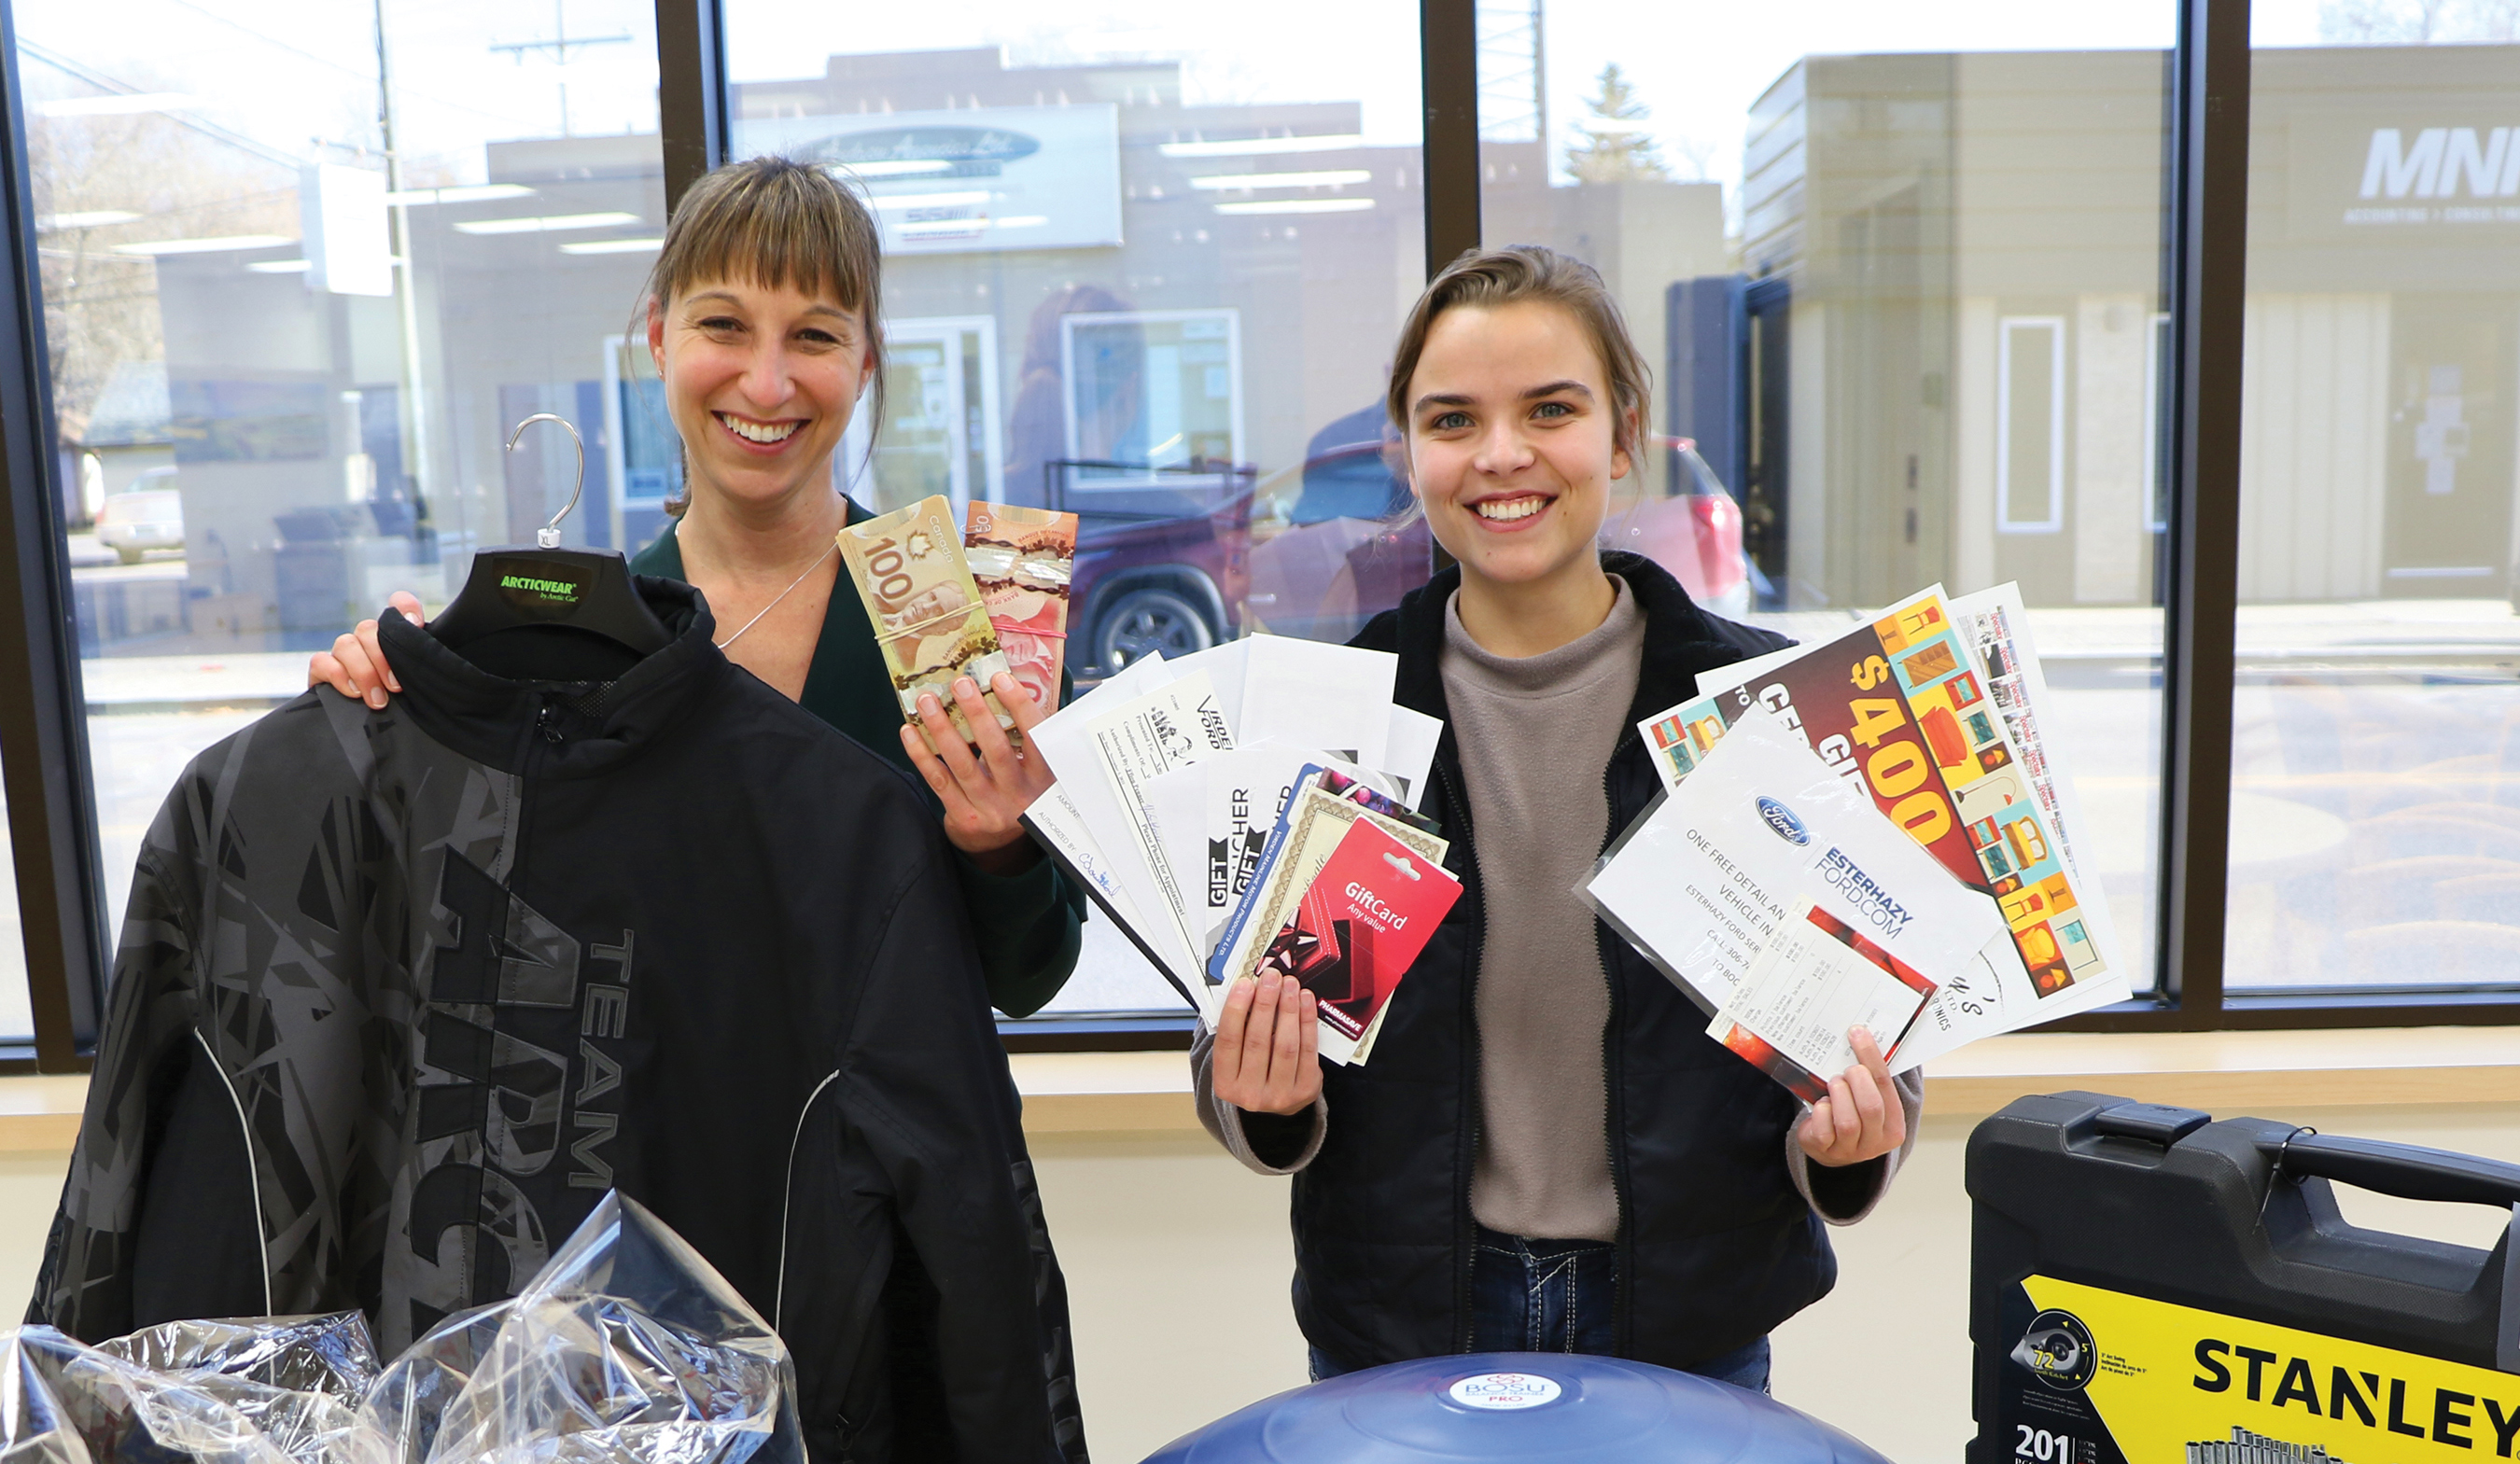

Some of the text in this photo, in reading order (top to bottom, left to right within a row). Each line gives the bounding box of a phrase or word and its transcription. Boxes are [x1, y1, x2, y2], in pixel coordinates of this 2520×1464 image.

[541, 536, 551, 546] XL
[929, 515, 954, 564] Canada
[500, 576, 573, 594] ARCTICWEAR
[863, 537, 914, 600] 100
[1734, 685, 1750, 706] TO
[1110, 728, 1126, 758] Authorized
[1123, 720, 1141, 757] Compliments
[1135, 715, 1150, 742] Presented
[1200, 710, 1221, 750] FORD
[1849, 655, 1952, 845] $400
[1037, 811, 1077, 851] AUTHORIZED BY:
[1762, 803, 1801, 843] Ford
[1141, 823, 1154, 844] Please
[1150, 844, 1162, 864] Phone
[1158, 864, 1167, 874] for
[1163, 875, 1185, 916] Appointment
[1211, 857, 1227, 904] GIFT
[1687, 829, 1711, 853] ONE
[1708, 848, 1736, 875] FREE
[1733, 871, 1769, 907] DETAIL
[1823, 846, 1913, 925] ESTERHAZY
[1345, 882, 1407, 930] GiftCard
[1347, 903, 1386, 933] Any value
[1685, 884, 1727, 922] ESTERHAZY
[1724, 919, 1746, 941] FORD
[1719, 884, 1762, 926] VEHICLE
[1813, 857, 1903, 940] FORD.COM
[1706, 928, 1728, 950] CALL:
[1712, 957, 1725, 971] TO
[1319, 999, 1363, 1032] PHARMASAVE
[1944, 990, 1958, 1013] LTD.
[567, 928, 635, 1190] TEAM
[2033, 1349, 2055, 1370] 72
[1465, 1384, 1545, 1393] BOSU
[2192, 1338, 2520, 1458] STANLEY
[2015, 1424, 2068, 1464] 201
